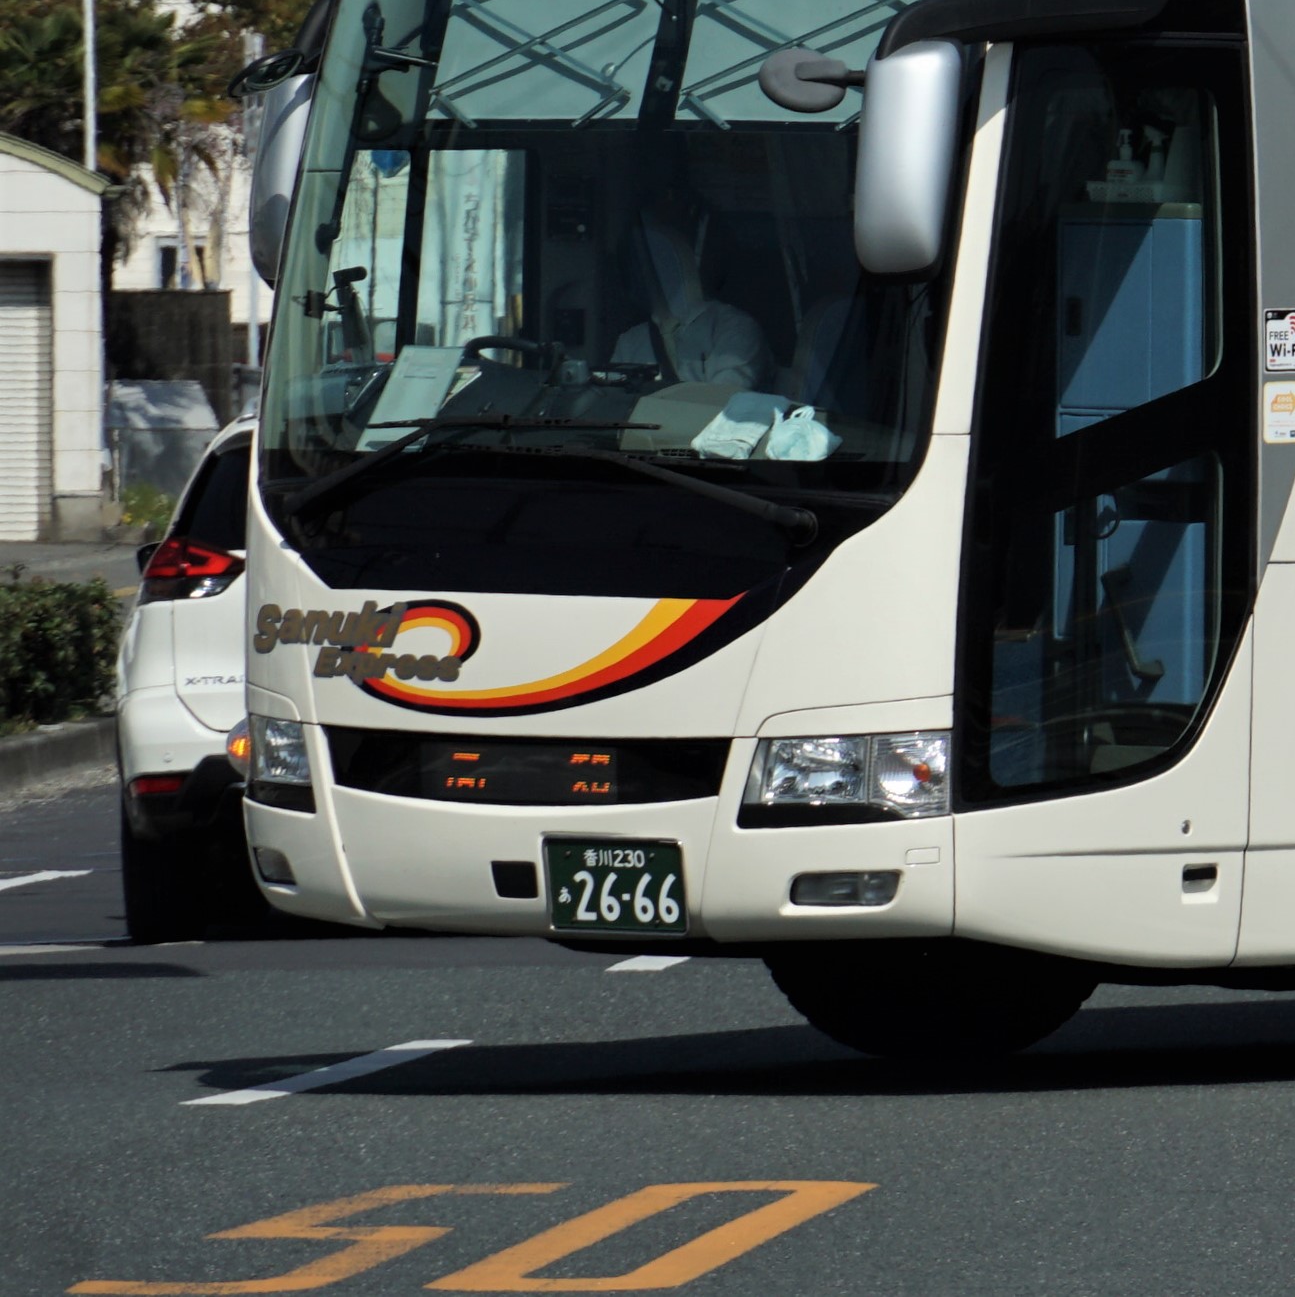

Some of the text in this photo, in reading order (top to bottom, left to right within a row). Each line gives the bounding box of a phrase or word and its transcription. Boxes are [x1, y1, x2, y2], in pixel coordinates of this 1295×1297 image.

[1269, 330, 1289, 341] FREE
[254, 600, 408, 654] Sanuki
[313, 647, 462, 685] Express
[583, 848, 645, 869] 香川230
[558, 870, 680, 924] あ 26-66
[64, 1180, 881, 1295] 50
